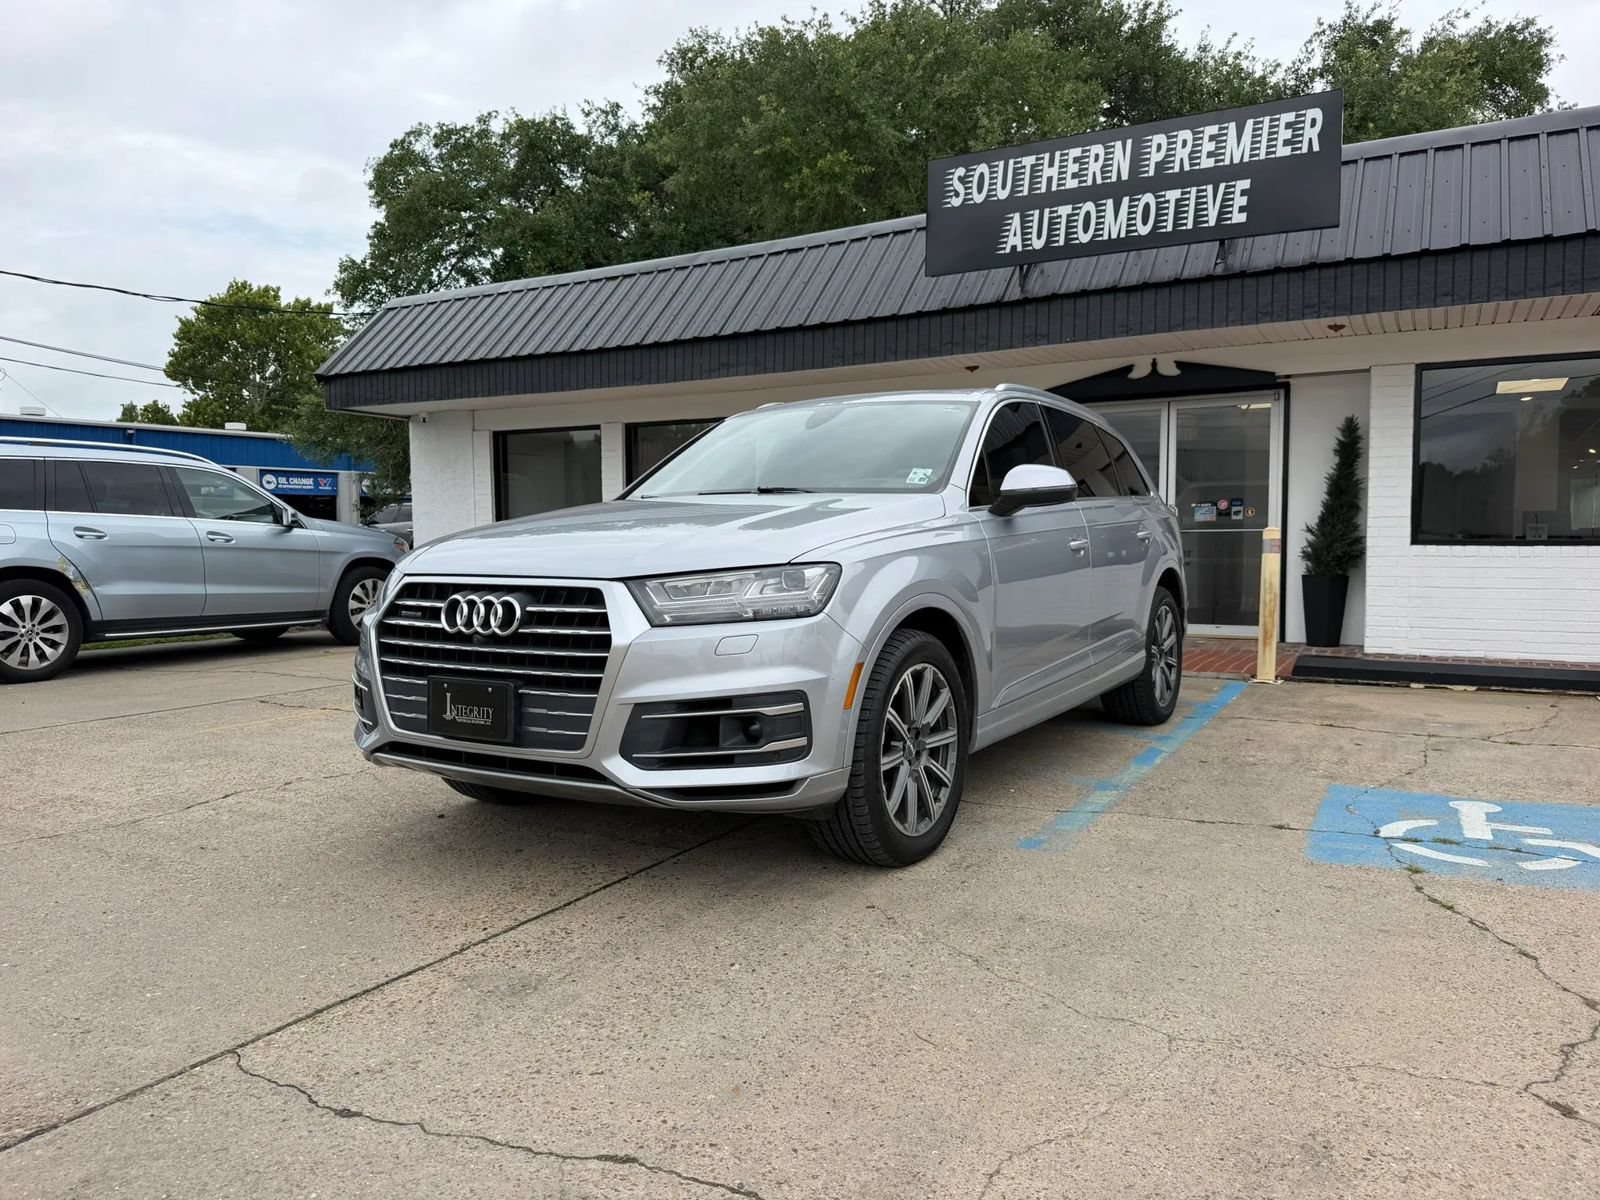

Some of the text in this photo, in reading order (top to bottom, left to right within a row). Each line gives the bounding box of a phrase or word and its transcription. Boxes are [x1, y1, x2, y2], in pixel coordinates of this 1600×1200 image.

[942, 107, 1324, 208] SOUTHERN PREMIER
[995, 179, 1251, 254] AUTOMOTIVE
[442, 692, 494, 720] INTEGRITY
